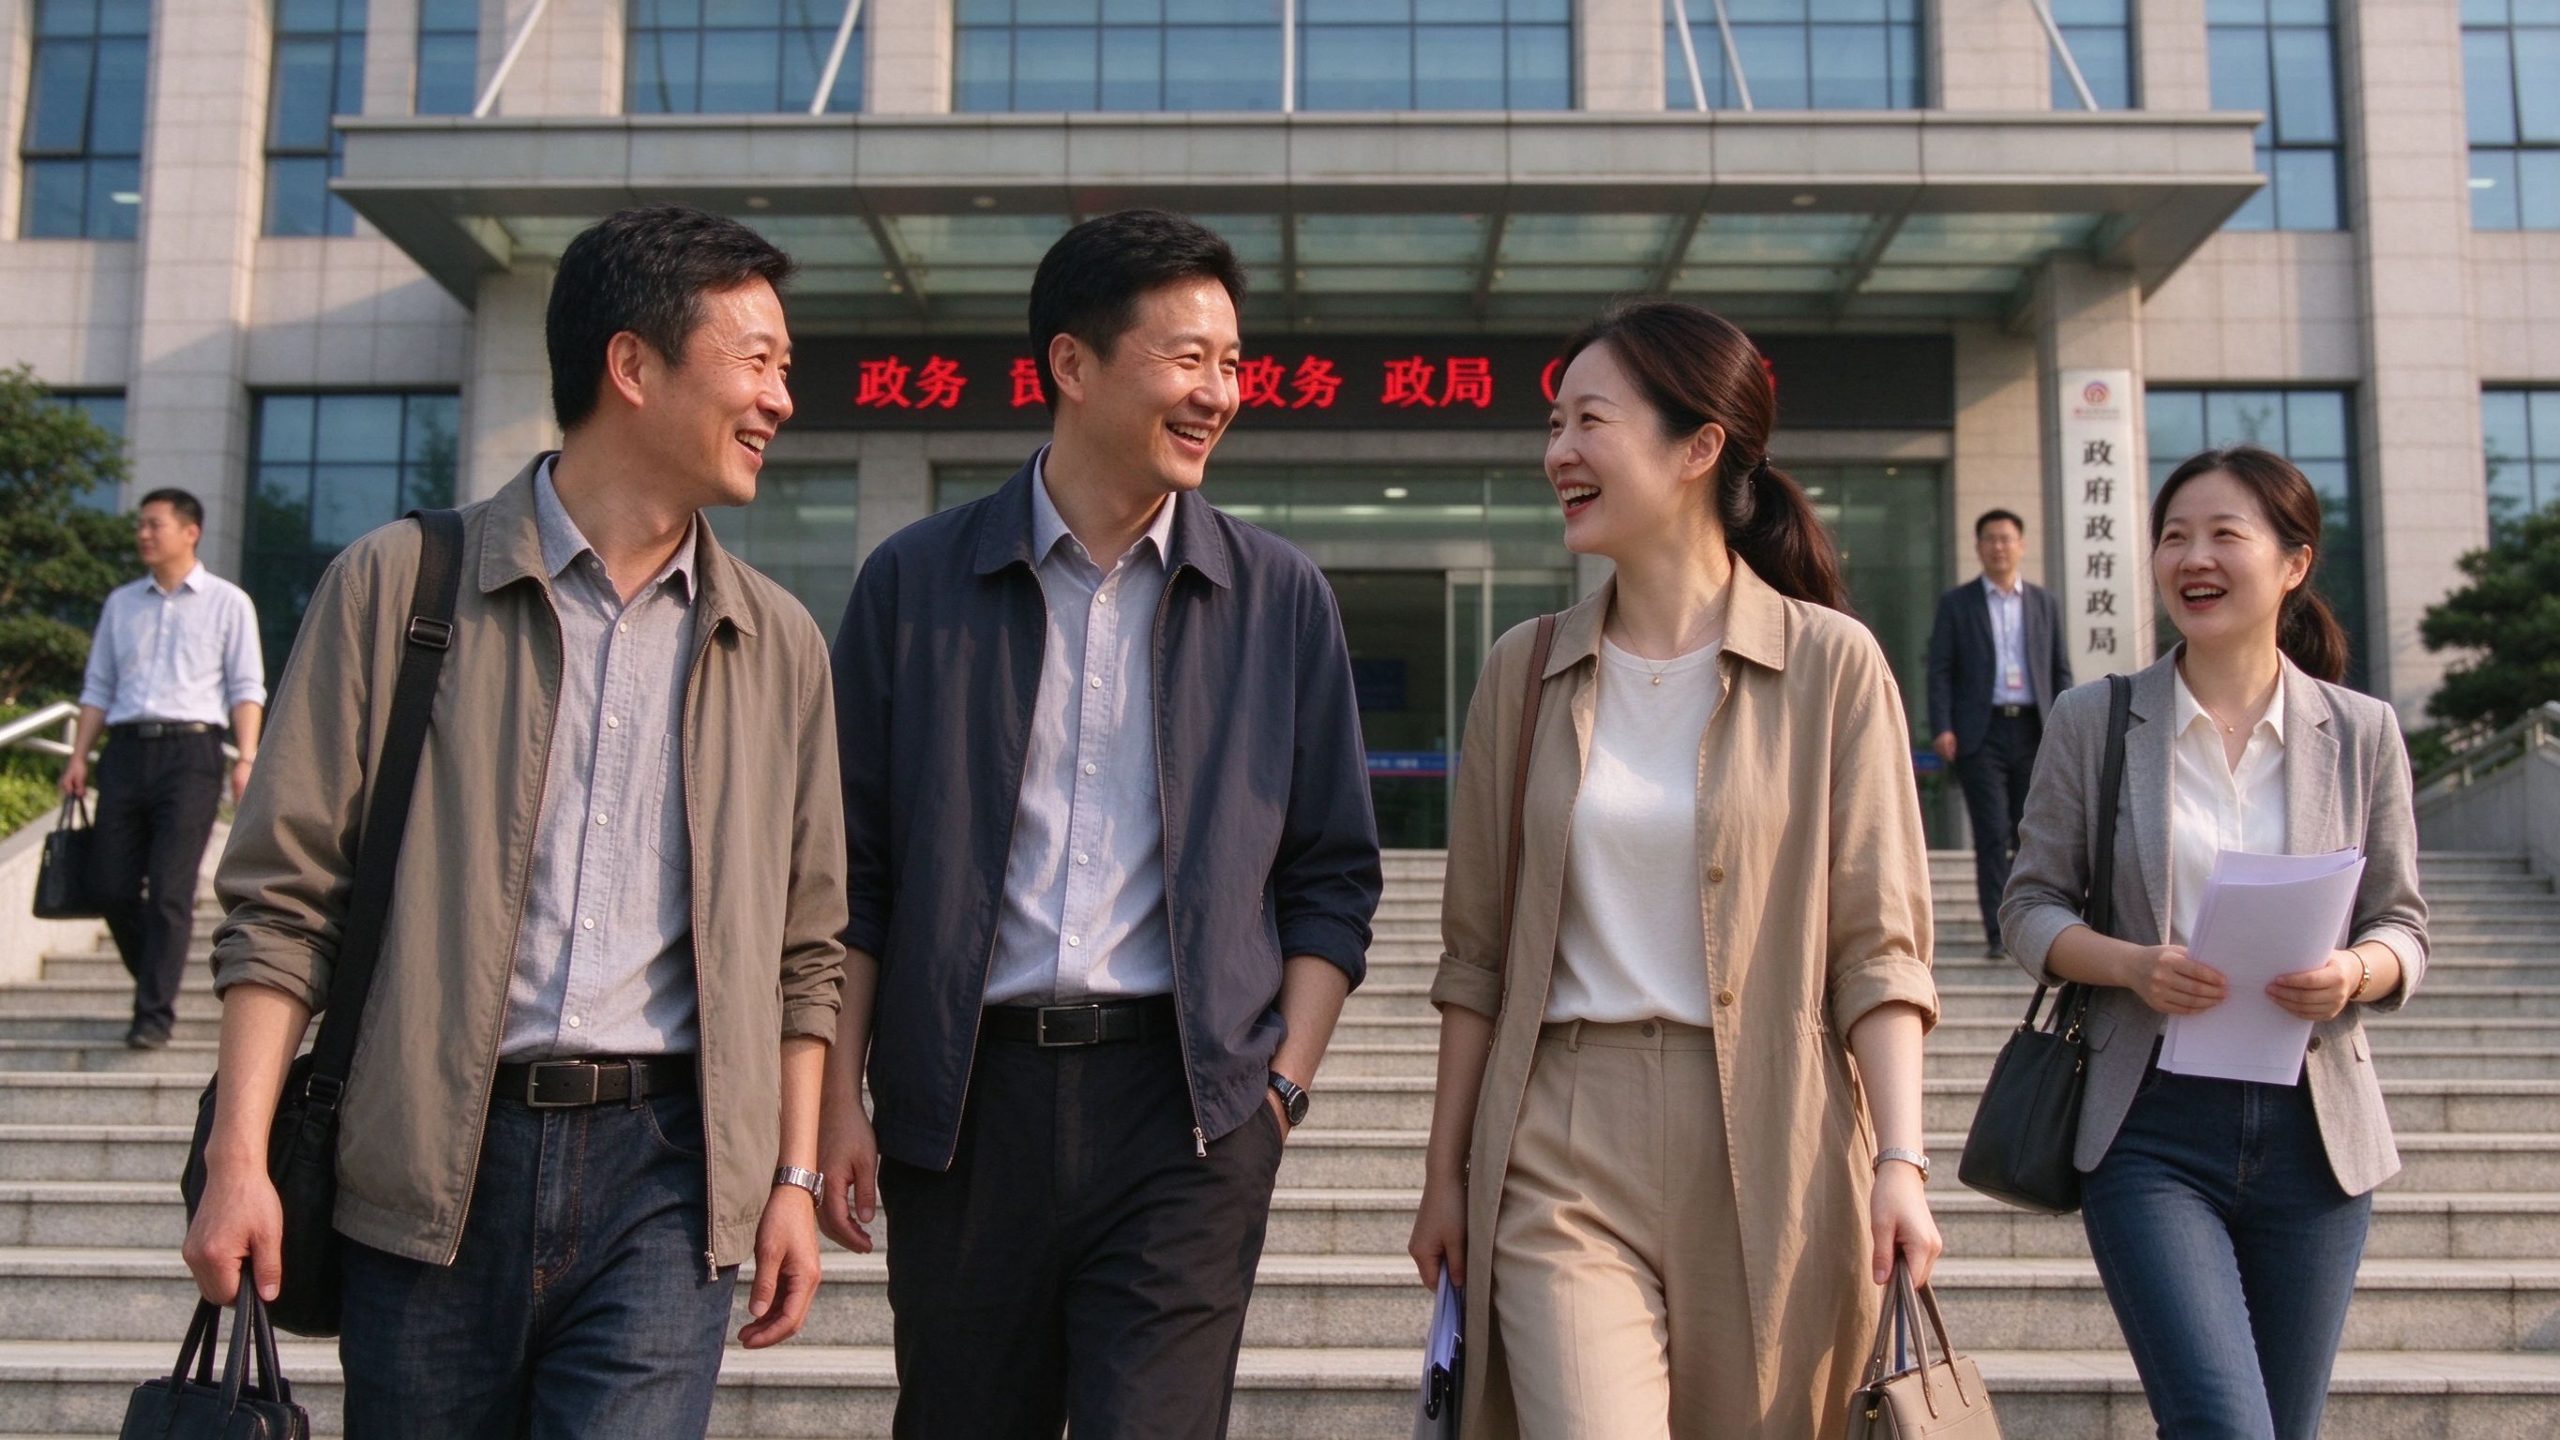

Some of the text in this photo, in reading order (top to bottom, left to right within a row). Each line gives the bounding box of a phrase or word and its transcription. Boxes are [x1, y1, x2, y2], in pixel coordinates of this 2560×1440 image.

[856, 355, 967, 408] 政务
[1239, 355, 1343, 408] 政务
[1381, 356, 1493, 408] 政局
[2082, 438, 2117, 655] 政府政府政局
